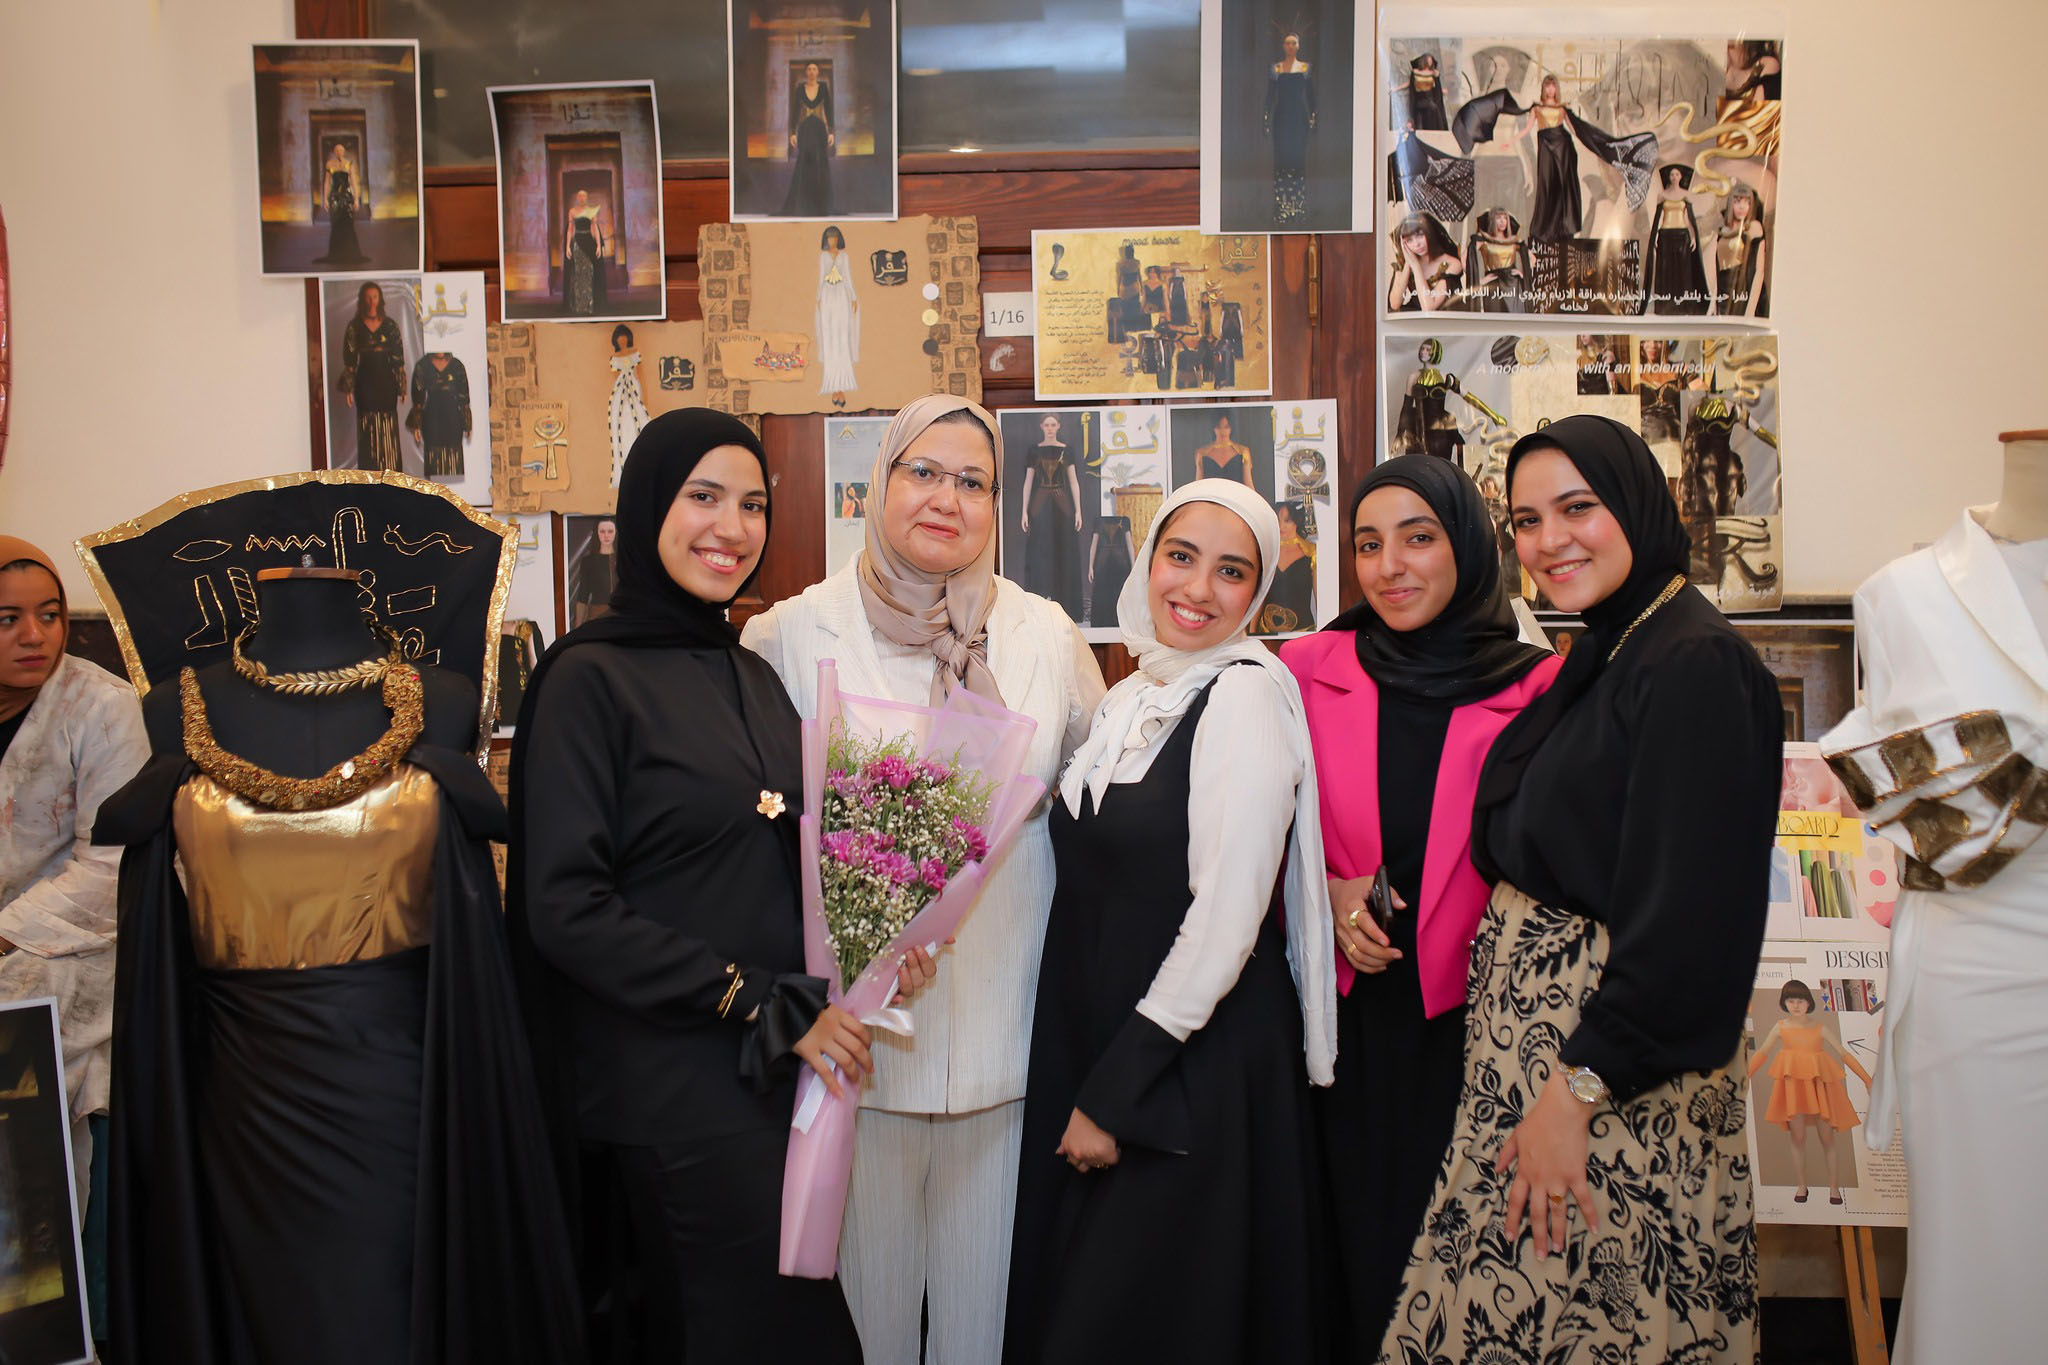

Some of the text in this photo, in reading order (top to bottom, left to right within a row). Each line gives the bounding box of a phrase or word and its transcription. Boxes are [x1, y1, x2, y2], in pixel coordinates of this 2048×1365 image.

[1674, 288, 1701, 305] يلتقي
[1732, 288, 1749, 304] نفرا
[990, 309, 1024, 326] 1/16
[1584, 361, 1610, 375] with
[1614, 363, 1631, 374] an
[1778, 815, 1839, 835] BOARD
